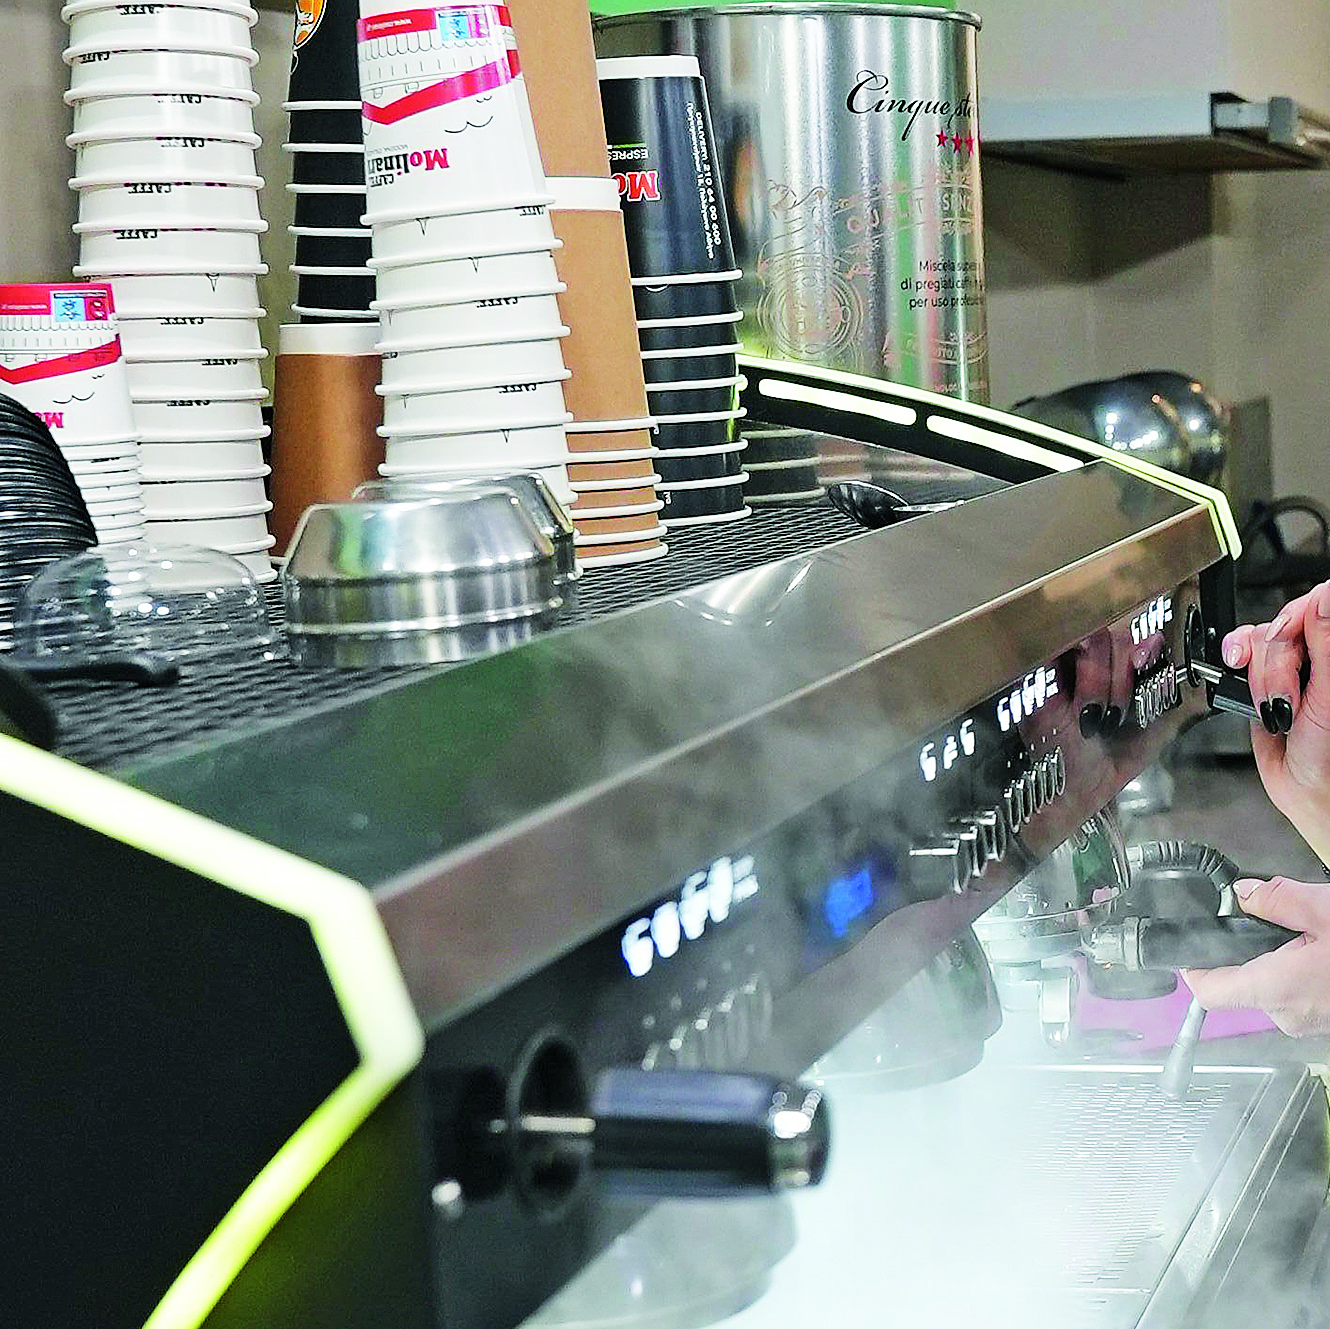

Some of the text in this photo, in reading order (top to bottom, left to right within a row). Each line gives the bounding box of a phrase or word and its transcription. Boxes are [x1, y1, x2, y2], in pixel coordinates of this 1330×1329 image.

[846, 69, 951, 142] Cinque
[703, 163, 713, 186] 210
[900, 277, 912, 290] di
[909, 298, 928, 311] per
[931, 298, 949, 307] uso
